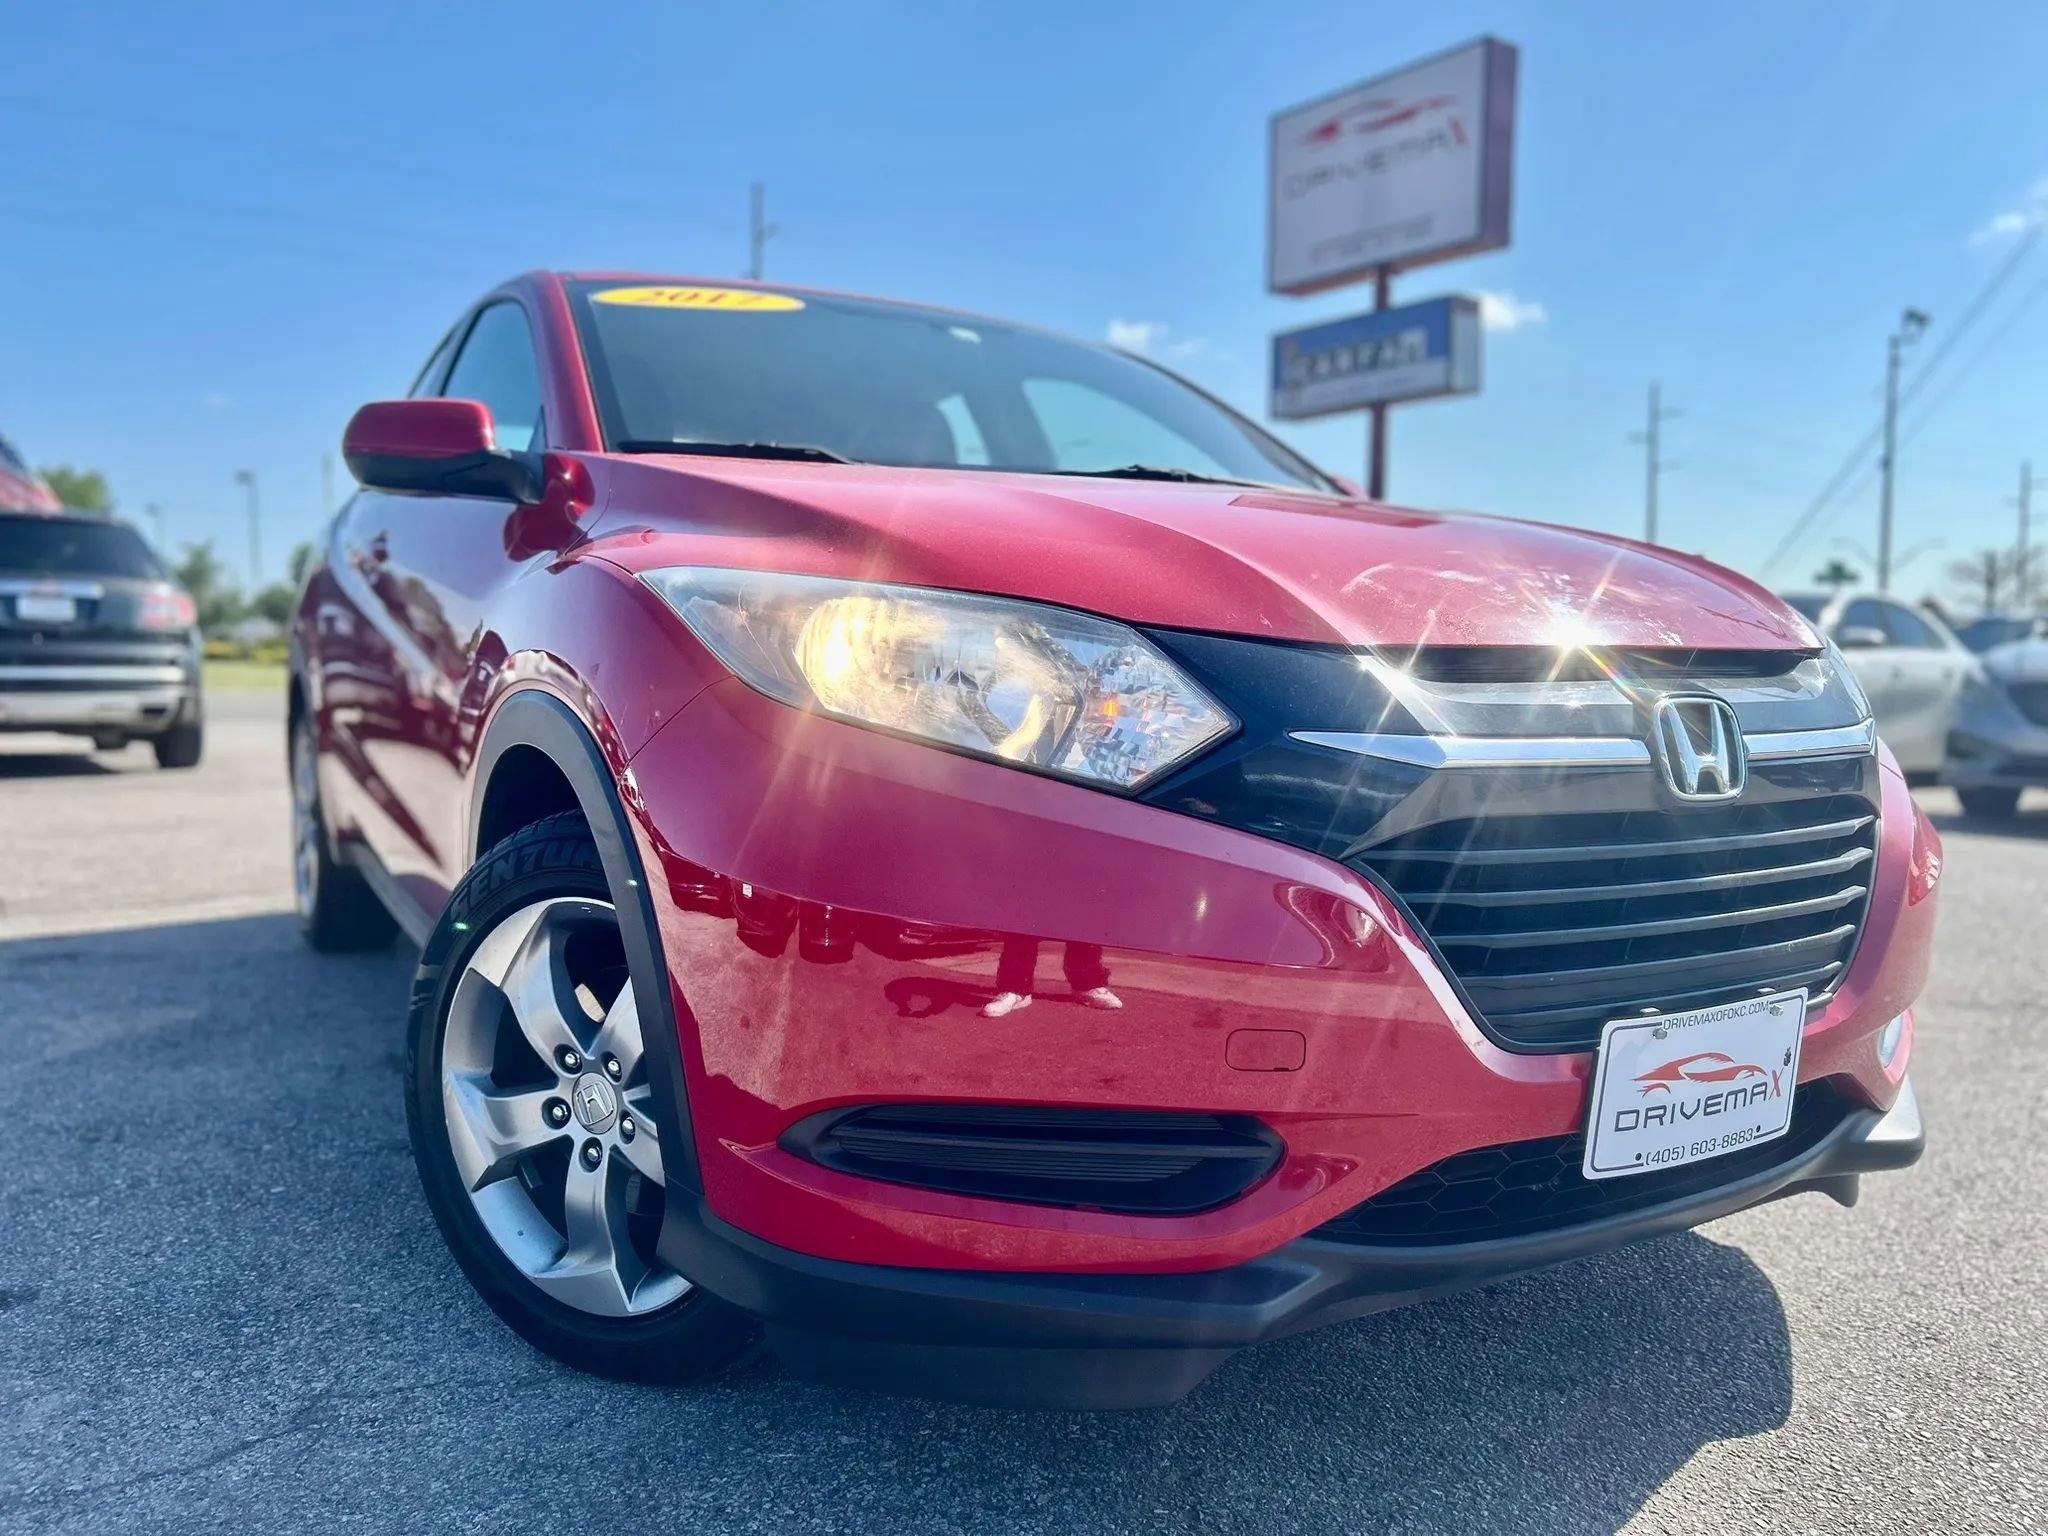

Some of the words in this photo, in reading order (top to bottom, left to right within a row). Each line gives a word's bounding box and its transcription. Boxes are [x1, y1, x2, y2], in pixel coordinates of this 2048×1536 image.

[1663, 1000, 1769, 1031] DRIVEMAXOFOKC.COM
[1614, 1070, 1783, 1132] DRIVEMAX
[1645, 1146, 1685, 1165] (405)
[1691, 1129, 1754, 1156] 603-8883
